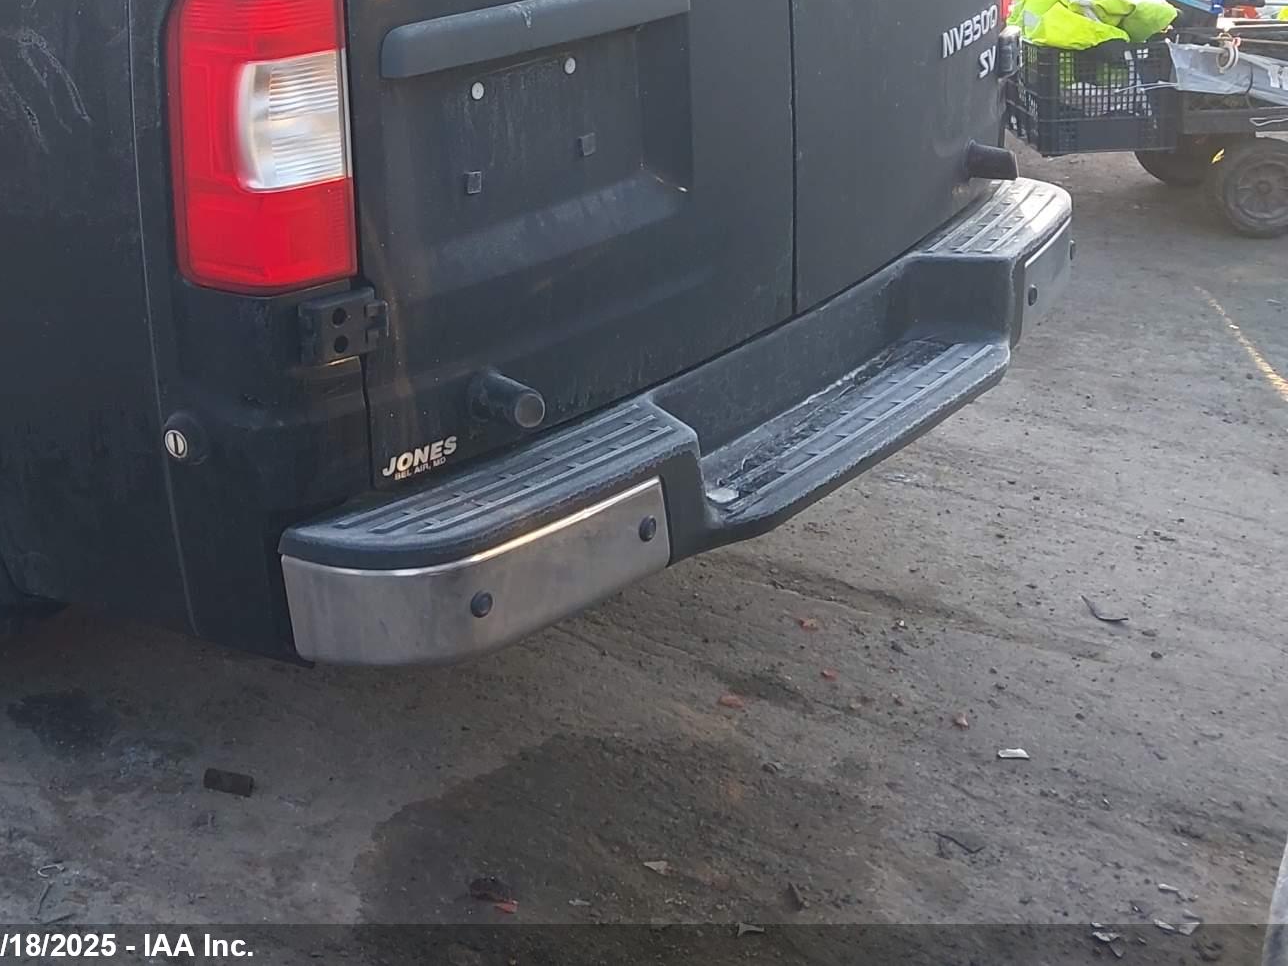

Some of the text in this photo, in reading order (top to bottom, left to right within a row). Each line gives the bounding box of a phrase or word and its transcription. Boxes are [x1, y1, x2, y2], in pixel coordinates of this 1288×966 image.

[942, 4, 998, 59] NV3500
[979, 45, 996, 79] SV
[382, 435, 457, 477] JONES
[394, 470, 412, 480] BEL
[433, 456, 447, 467] MD
